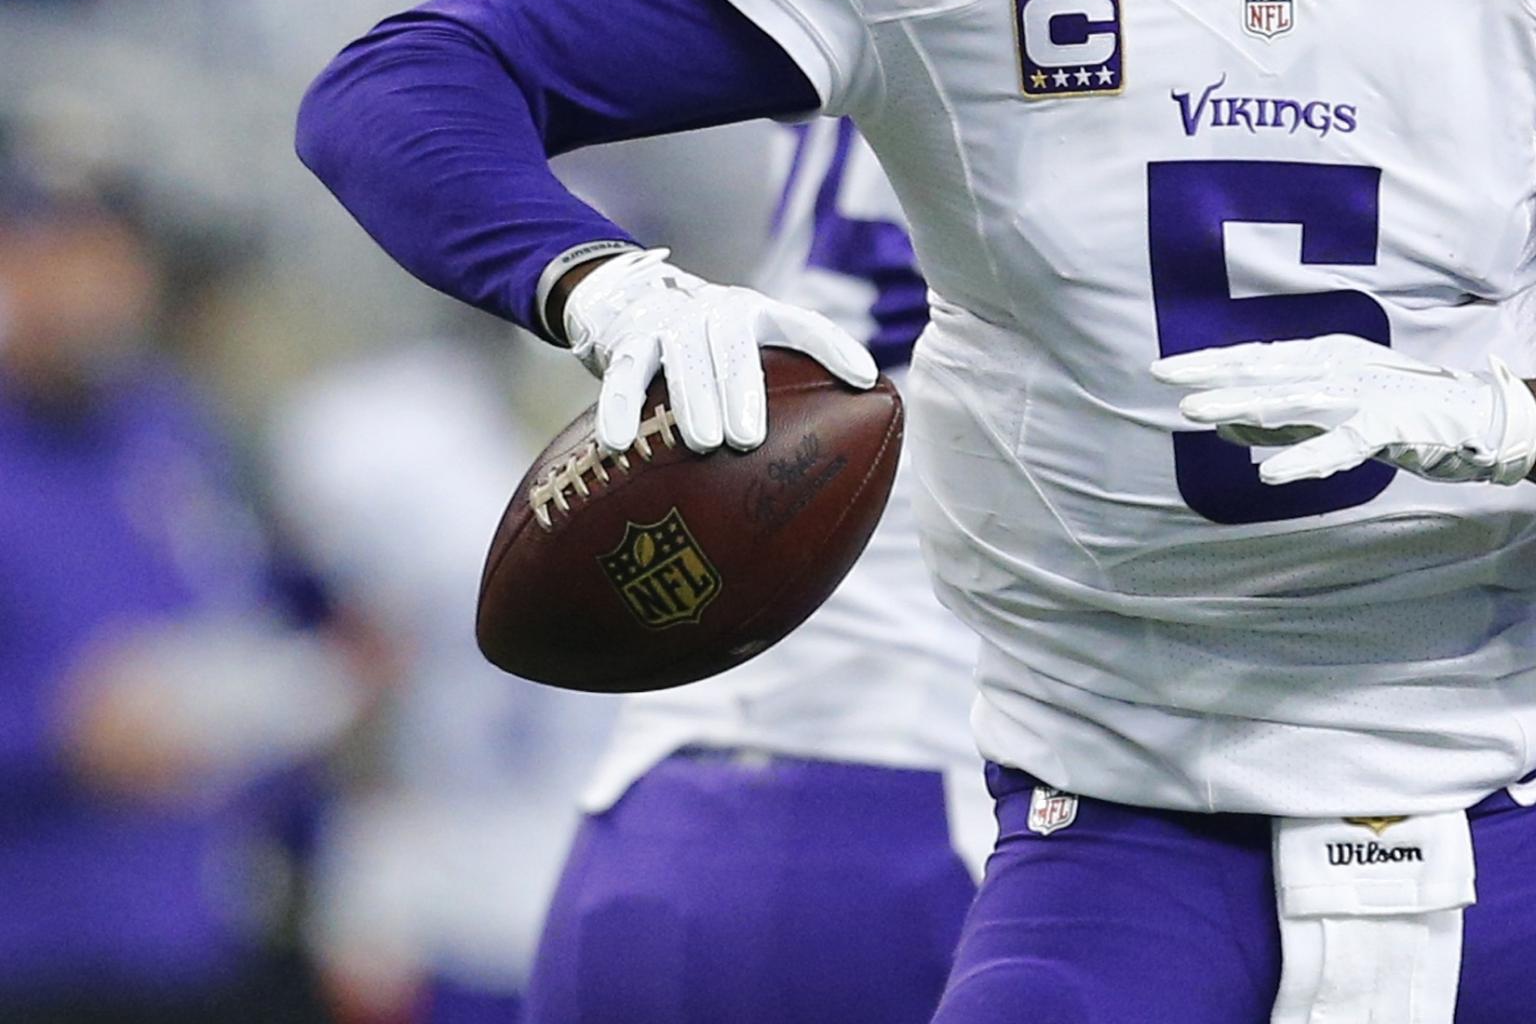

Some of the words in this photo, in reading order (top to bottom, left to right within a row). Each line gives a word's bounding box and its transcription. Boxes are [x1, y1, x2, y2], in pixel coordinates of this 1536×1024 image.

[1250, 2, 1290, 32] NFL
[1171, 72, 1358, 138] VIKINGS
[1146, 159, 1397, 525] 5
[628, 547, 711, 621] NFL
[1327, 842, 1423, 867] Wilson
